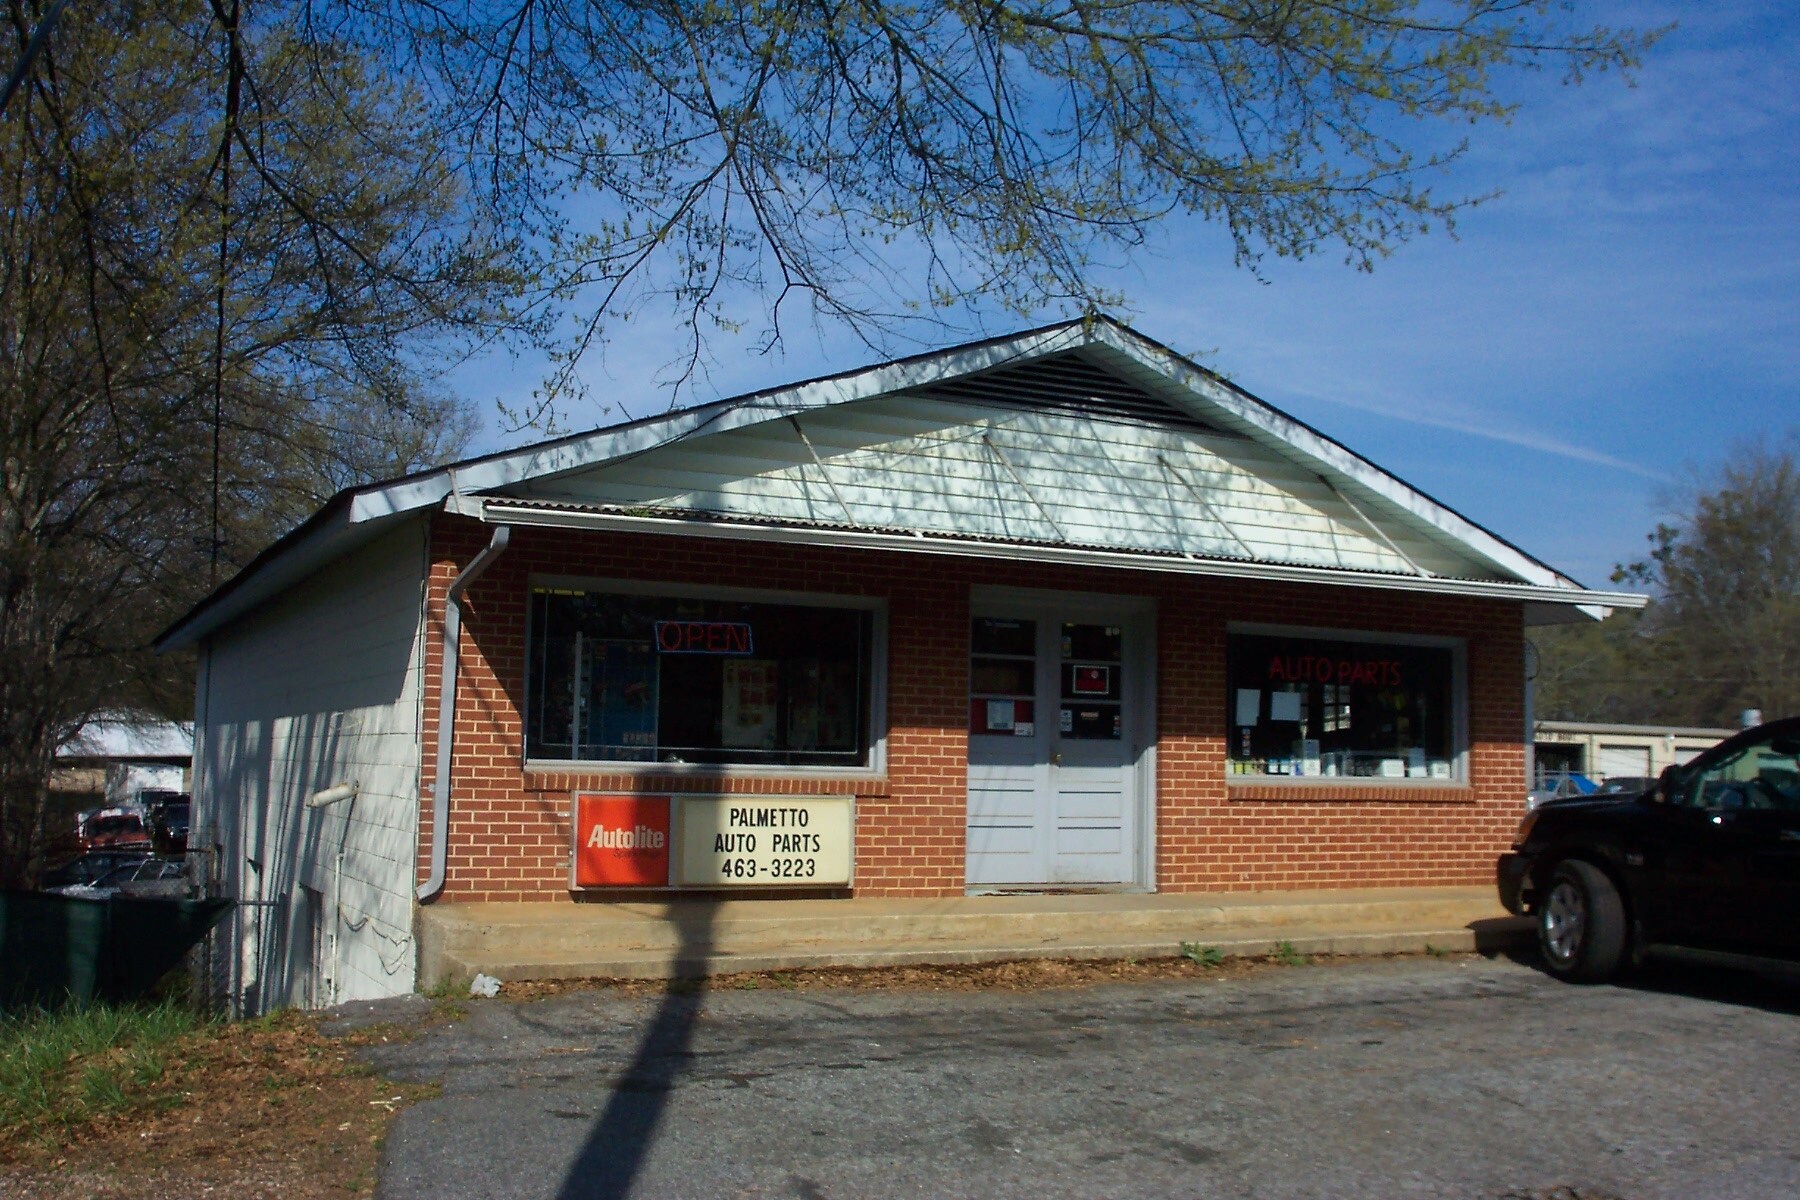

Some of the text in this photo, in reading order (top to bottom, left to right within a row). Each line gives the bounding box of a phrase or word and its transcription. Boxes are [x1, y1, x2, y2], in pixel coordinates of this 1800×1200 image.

[660, 622, 747, 652] OPEN
[1267, 656, 1402, 688] AUTO PARTS
[730, 808, 809, 827] PALMETTO
[587, 824, 665, 849] Autolite
[714, 833, 820, 853] AUTO PARTS
[721, 858, 816, 878] 463-3223
